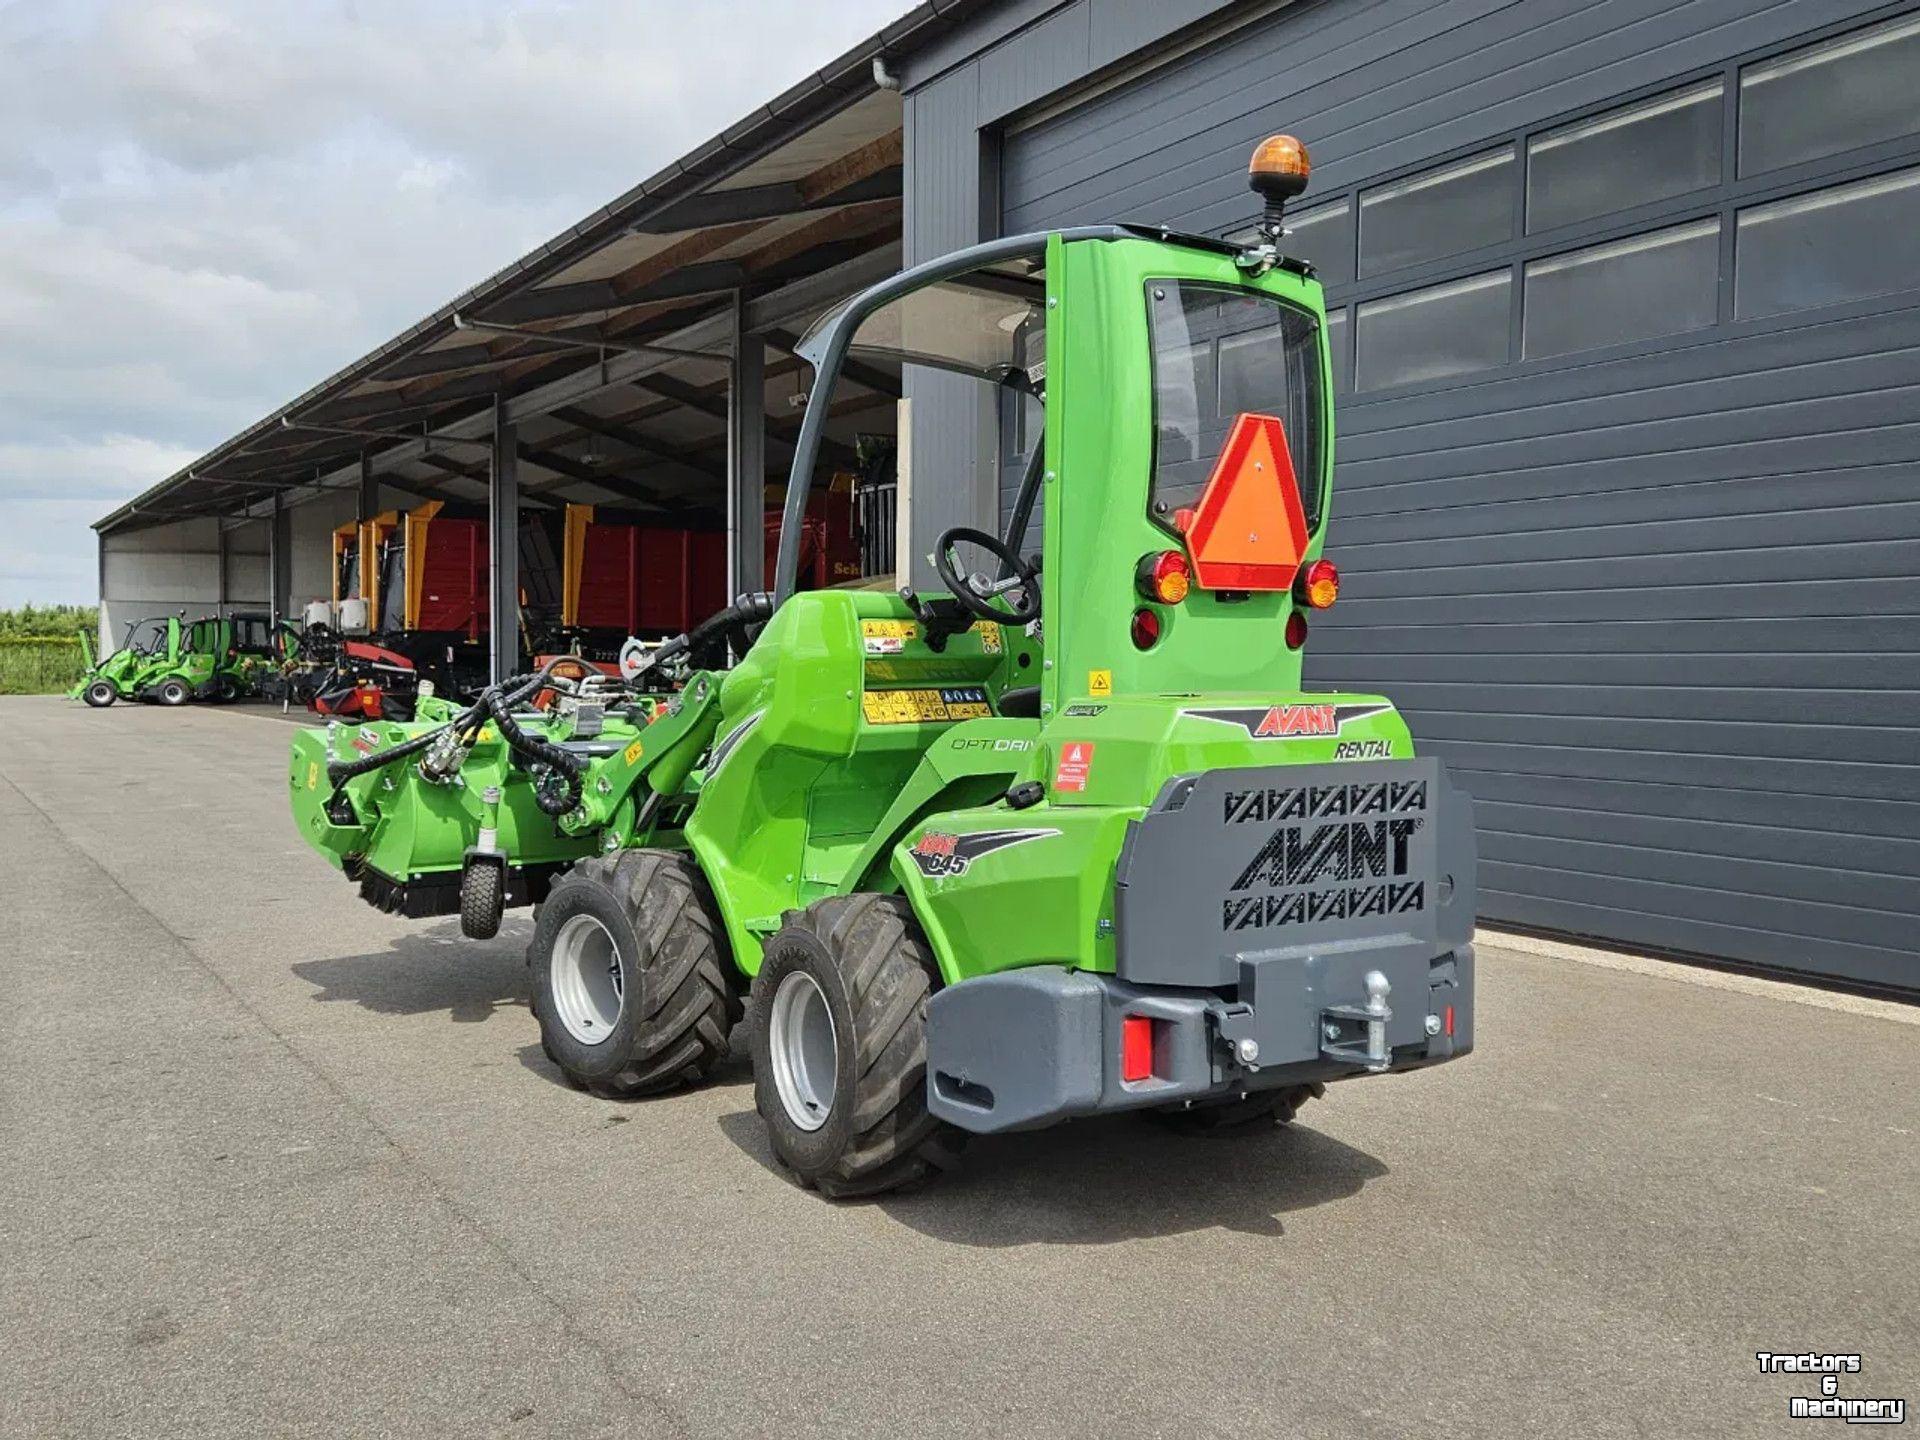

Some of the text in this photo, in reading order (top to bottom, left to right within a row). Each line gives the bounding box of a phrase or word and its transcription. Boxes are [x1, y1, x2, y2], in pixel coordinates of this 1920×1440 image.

[1253, 704, 1337, 736] AVANT
[1333, 741, 1392, 759] RENTAL
[928, 853, 968, 876] 645
